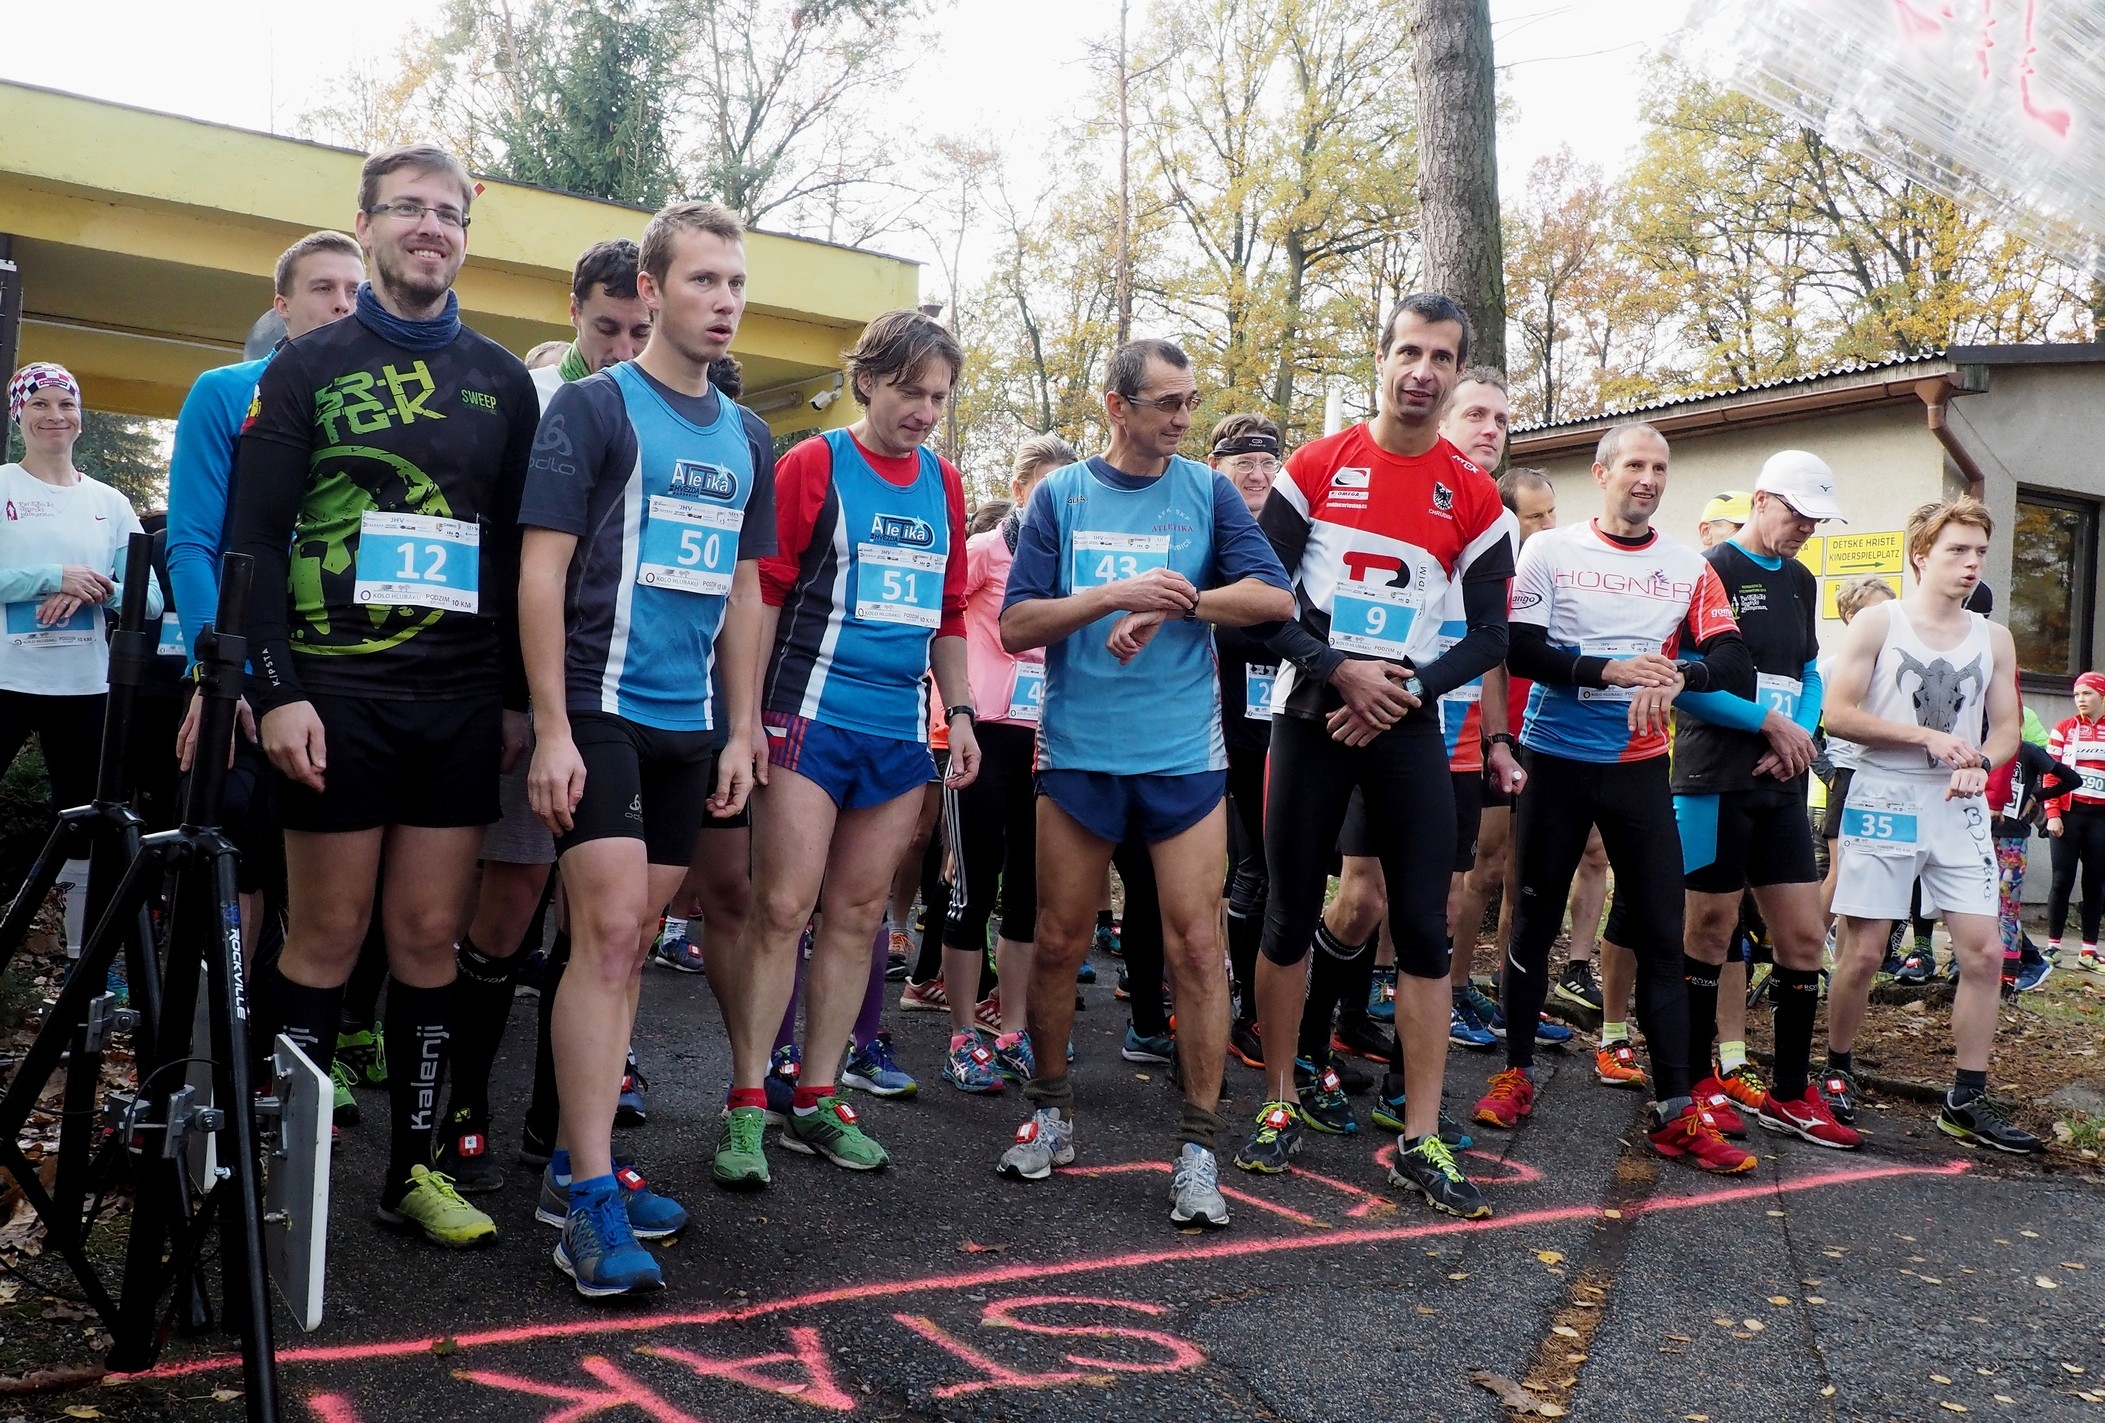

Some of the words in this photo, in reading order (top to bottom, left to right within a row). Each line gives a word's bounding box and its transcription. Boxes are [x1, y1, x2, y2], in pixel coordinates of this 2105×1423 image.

[460, 388, 497, 411] SWEEP
[679, 504, 693, 512] JHV
[1428, 508, 1453, 520] CHRUDIM
[1152, 524, 1194, 532] ATLETIKA
[677, 529, 720, 569] 50
[1169, 538, 1192, 551] UBICE
[1829, 550, 1900, 562] KINDERSPIELPLATZ
[396, 542, 447, 582] 12
[1095, 554, 1138, 582] 43
[882, 570, 918, 604] 51
[1555, 568, 1693, 600] HÖGNER
[425, 594, 450, 603] PODZIM
[460, 600, 472, 608] KM
[1365, 606, 1387, 635] 9
[1374, 645, 1395, 654] PODZIM
[262, 648, 280, 687] KIPSTA
[1028, 681, 1041, 704] 4
[1259, 682, 1274, 704] 2
[1771, 692, 1793, 718] 21
[1860, 814, 1893, 838] 35
[228, 927, 247, 1021] ROCKVILLE
[1691, 976, 1719, 984] ROYAL
[410, 1025, 450, 1130] Kalenji
